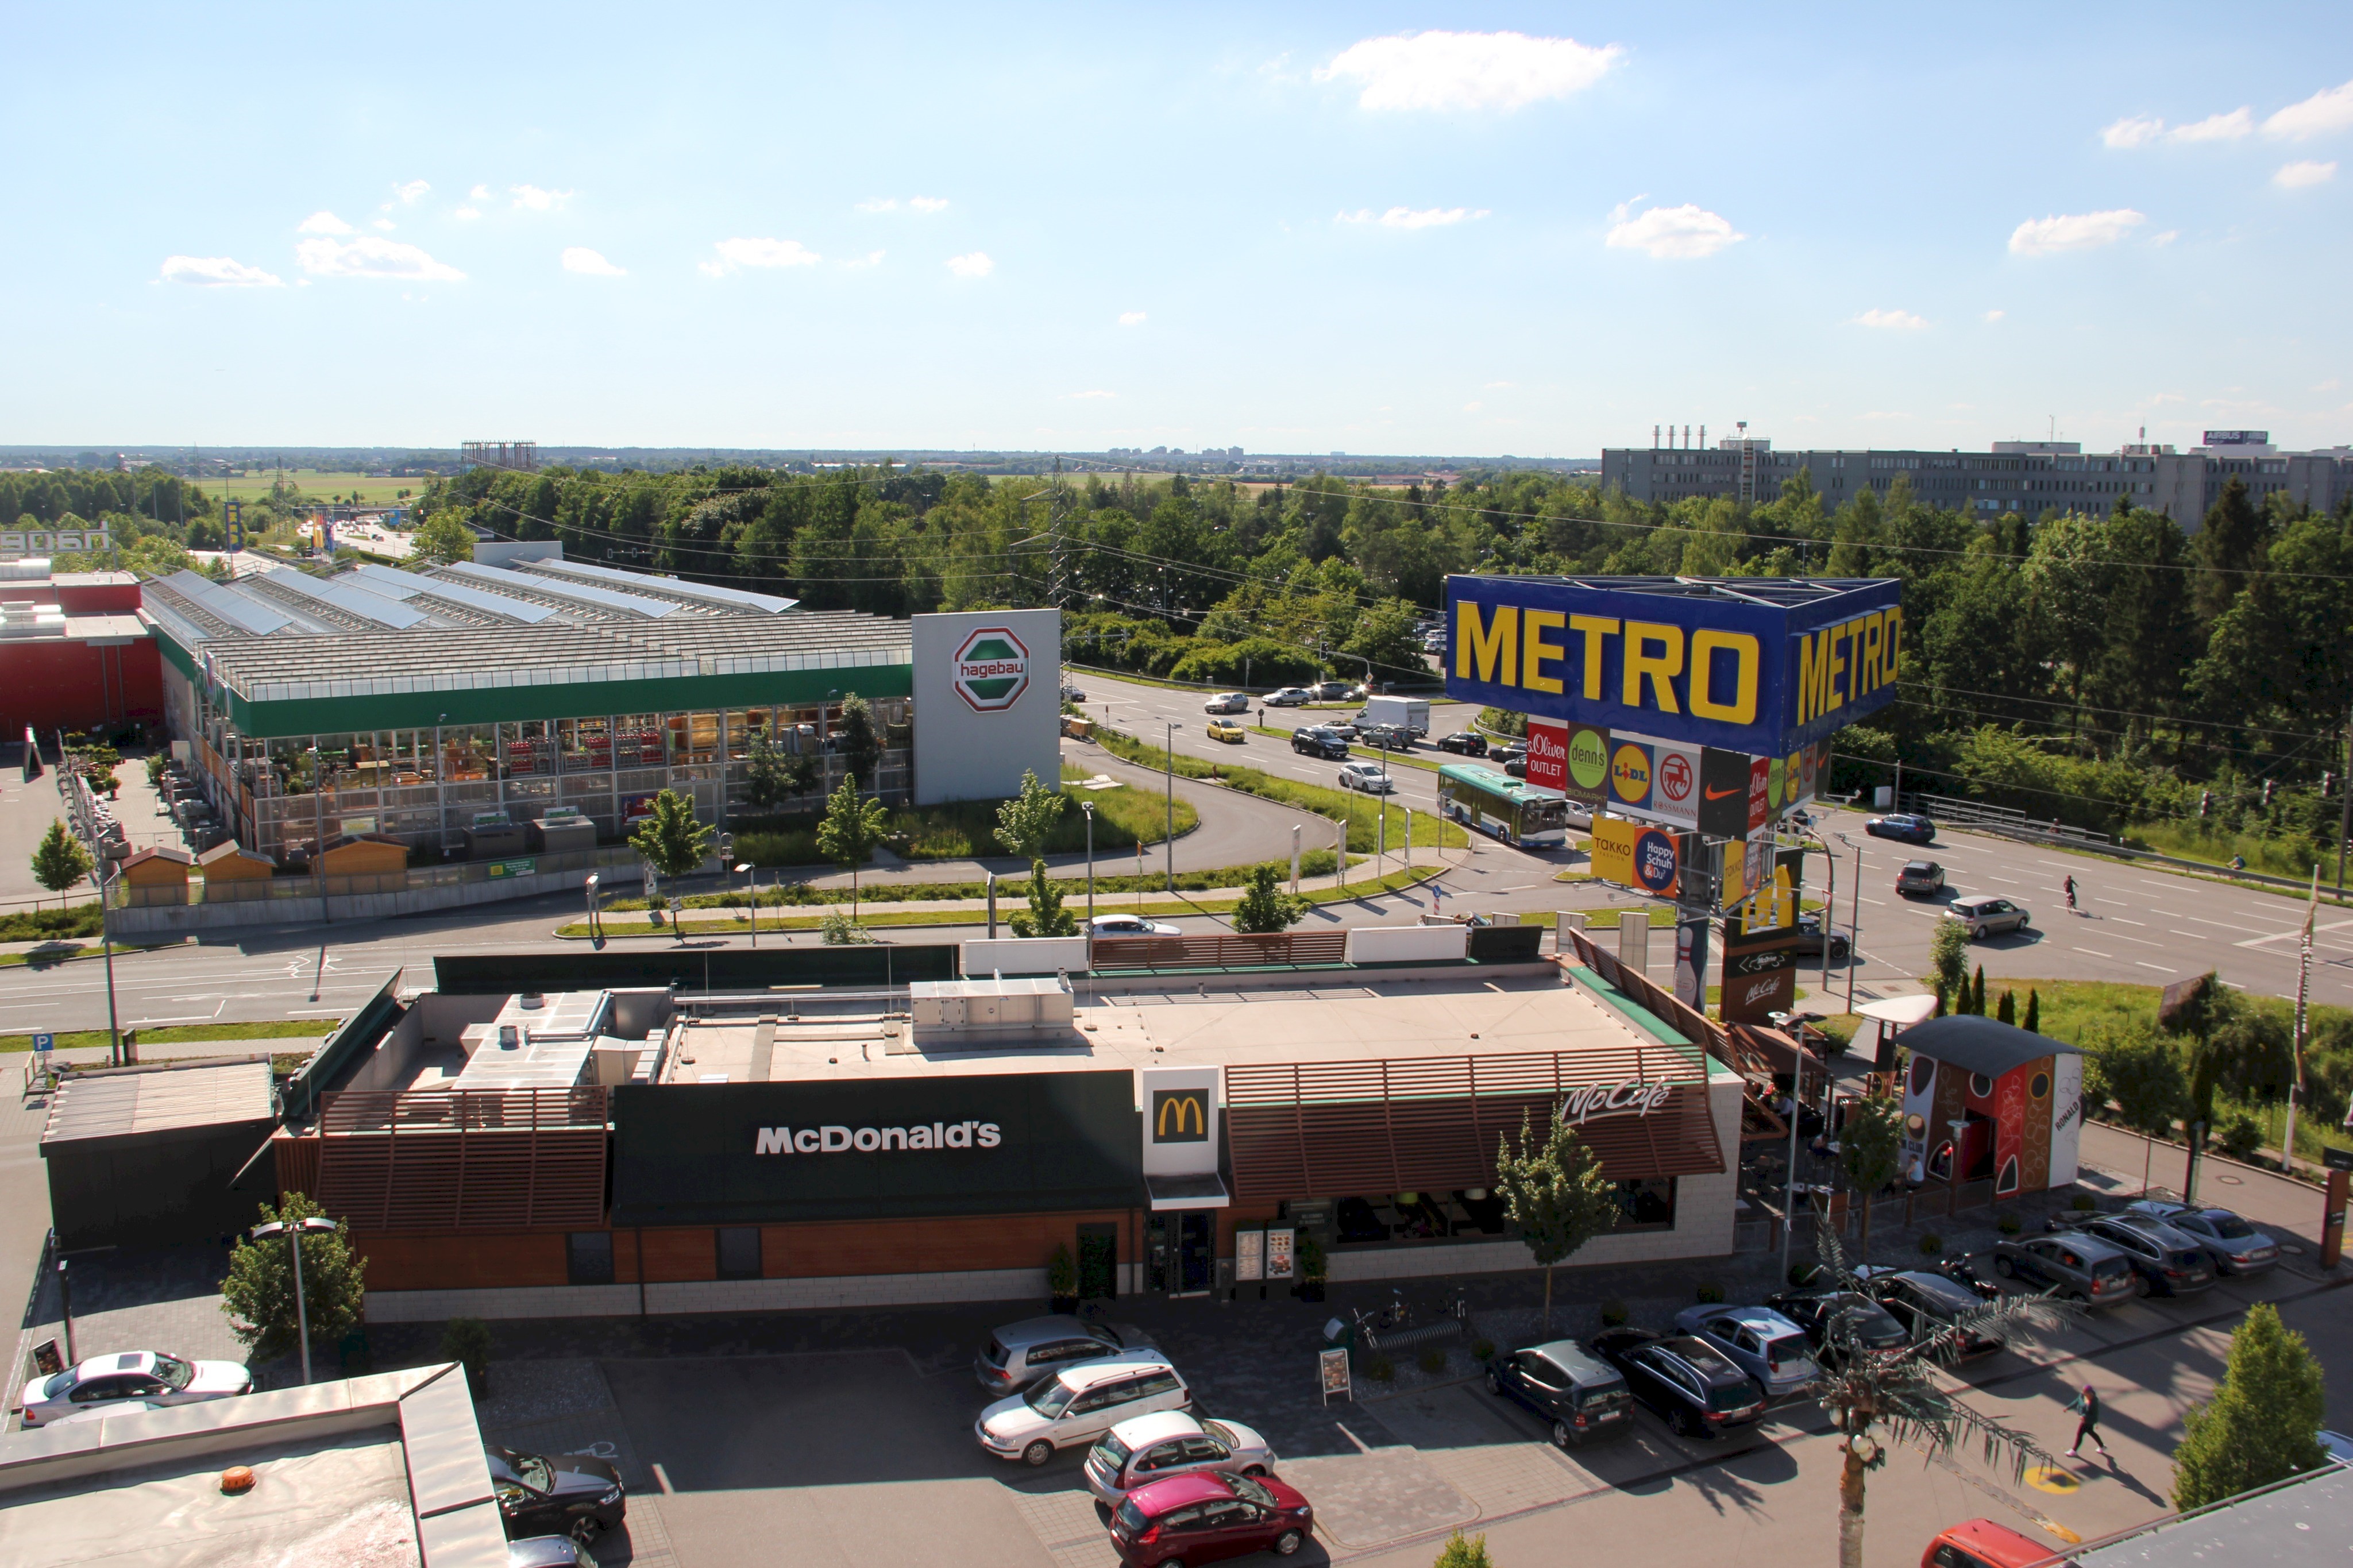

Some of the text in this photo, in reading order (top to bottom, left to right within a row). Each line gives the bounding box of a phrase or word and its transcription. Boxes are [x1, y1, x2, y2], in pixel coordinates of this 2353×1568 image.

[2207, 431, 2240, 439] AIRBUS
[961, 661, 1023, 678] hagebau
[1456, 600, 1759, 725] METRO
[1797, 605, 1901, 727] METRO
[1530, 760, 1562, 777] OUTLET
[1567, 787, 1607, 803] BIOMARKT
[1653, 800, 1697, 817] ROSSMANN
[1599, 851, 1625, 862] FASHION
[1647, 841, 1675, 859] Happy
[1646, 853, 1672, 870] Schuh
[1757, 956, 1777, 965] McDrive
[37, 1036, 49, 1049] P
[2055, 1101, 2079, 1131] RONALD
[756, 1121, 1001, 1154] McDonald's
[1909, 1141, 1923, 1154] CLUB
